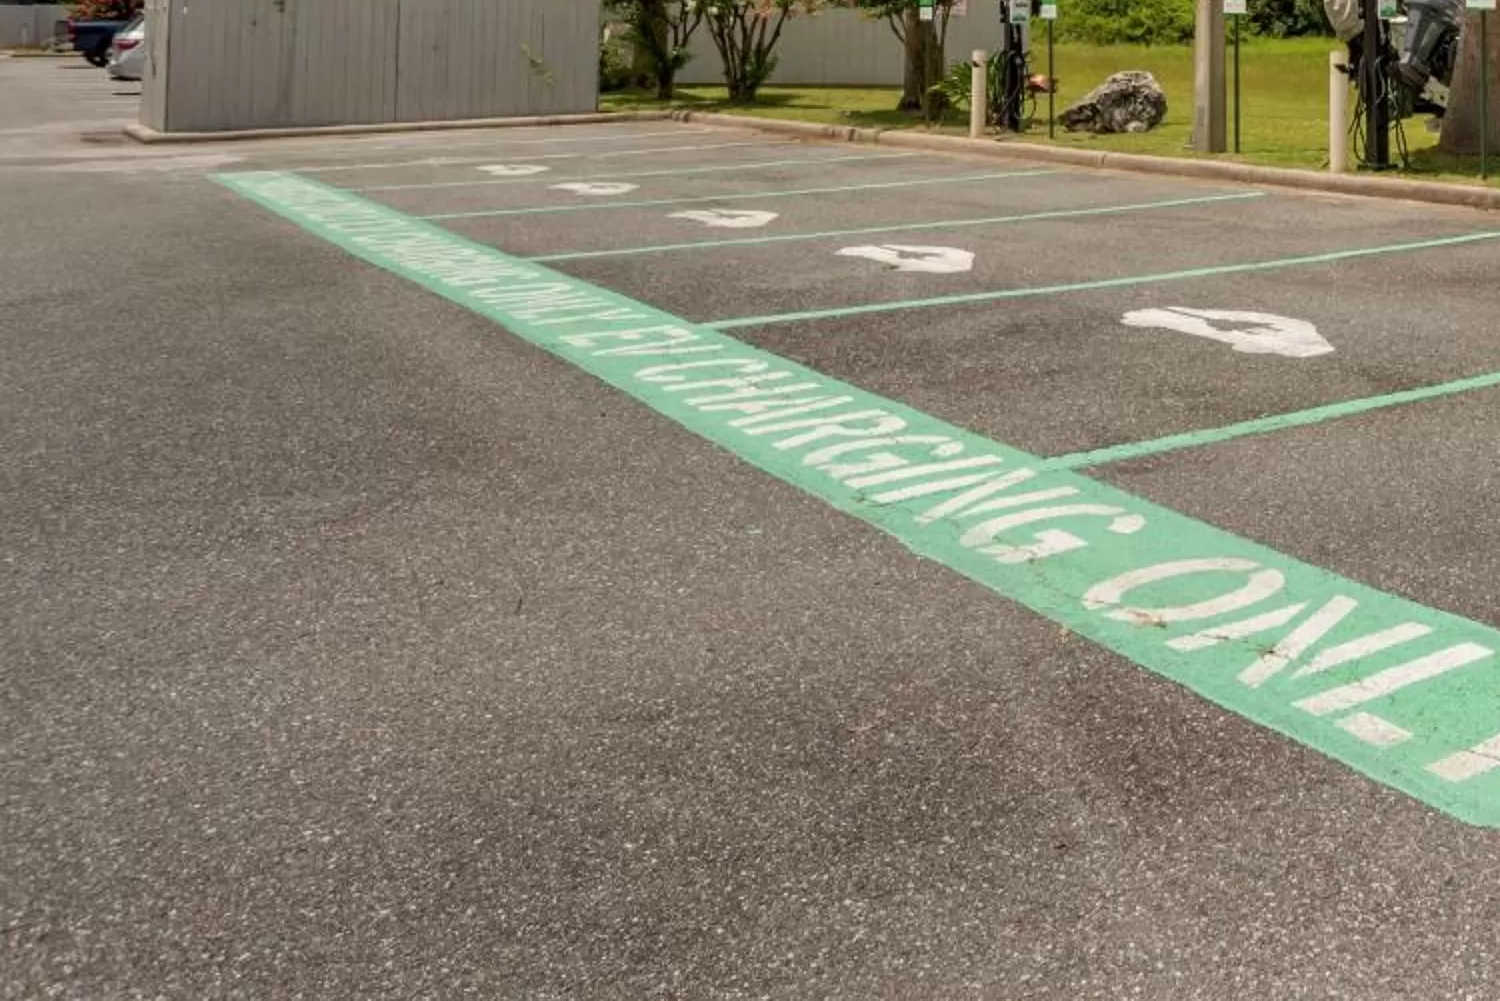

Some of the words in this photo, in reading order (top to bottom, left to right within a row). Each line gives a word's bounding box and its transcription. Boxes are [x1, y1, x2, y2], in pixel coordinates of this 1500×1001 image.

[467, 282, 649, 325] ONLY
[559, 325, 723, 357] EV
[634, 358, 1146, 563] CHARGING
